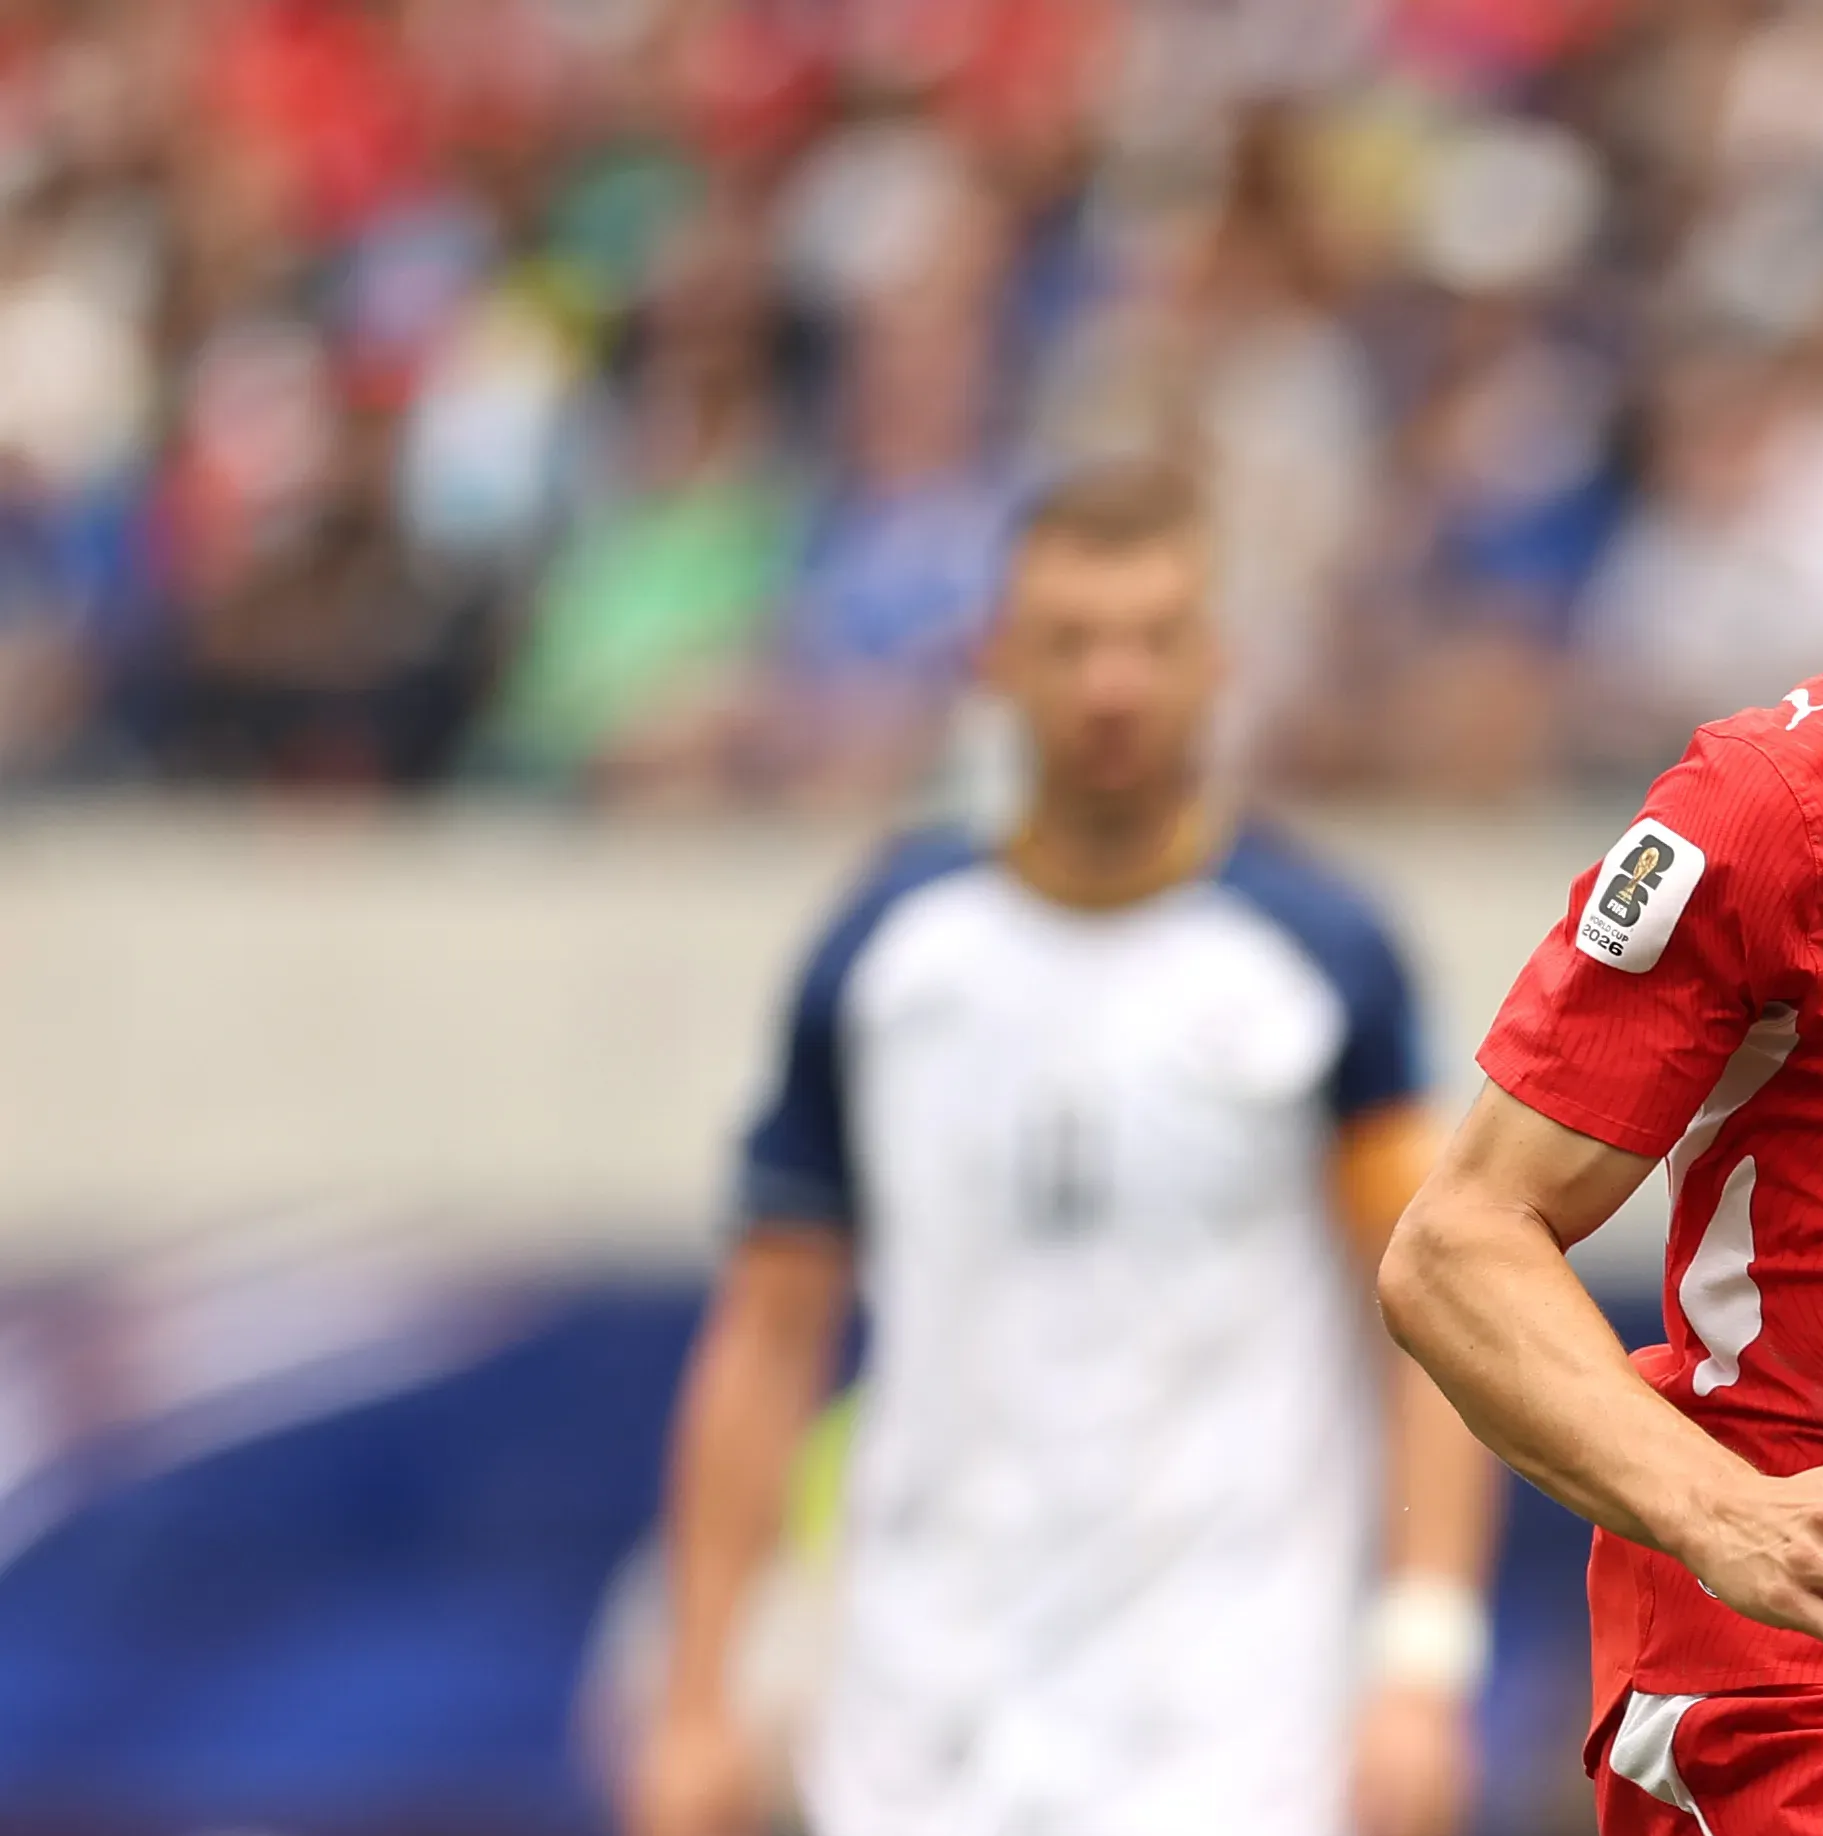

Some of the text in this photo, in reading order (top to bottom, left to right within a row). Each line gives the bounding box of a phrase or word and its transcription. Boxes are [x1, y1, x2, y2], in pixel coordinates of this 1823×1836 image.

[1606, 898, 1629, 919] FIFA
[1581, 924, 1625, 957] 2026
[1589, 915, 1630, 943] WORLD CUP
